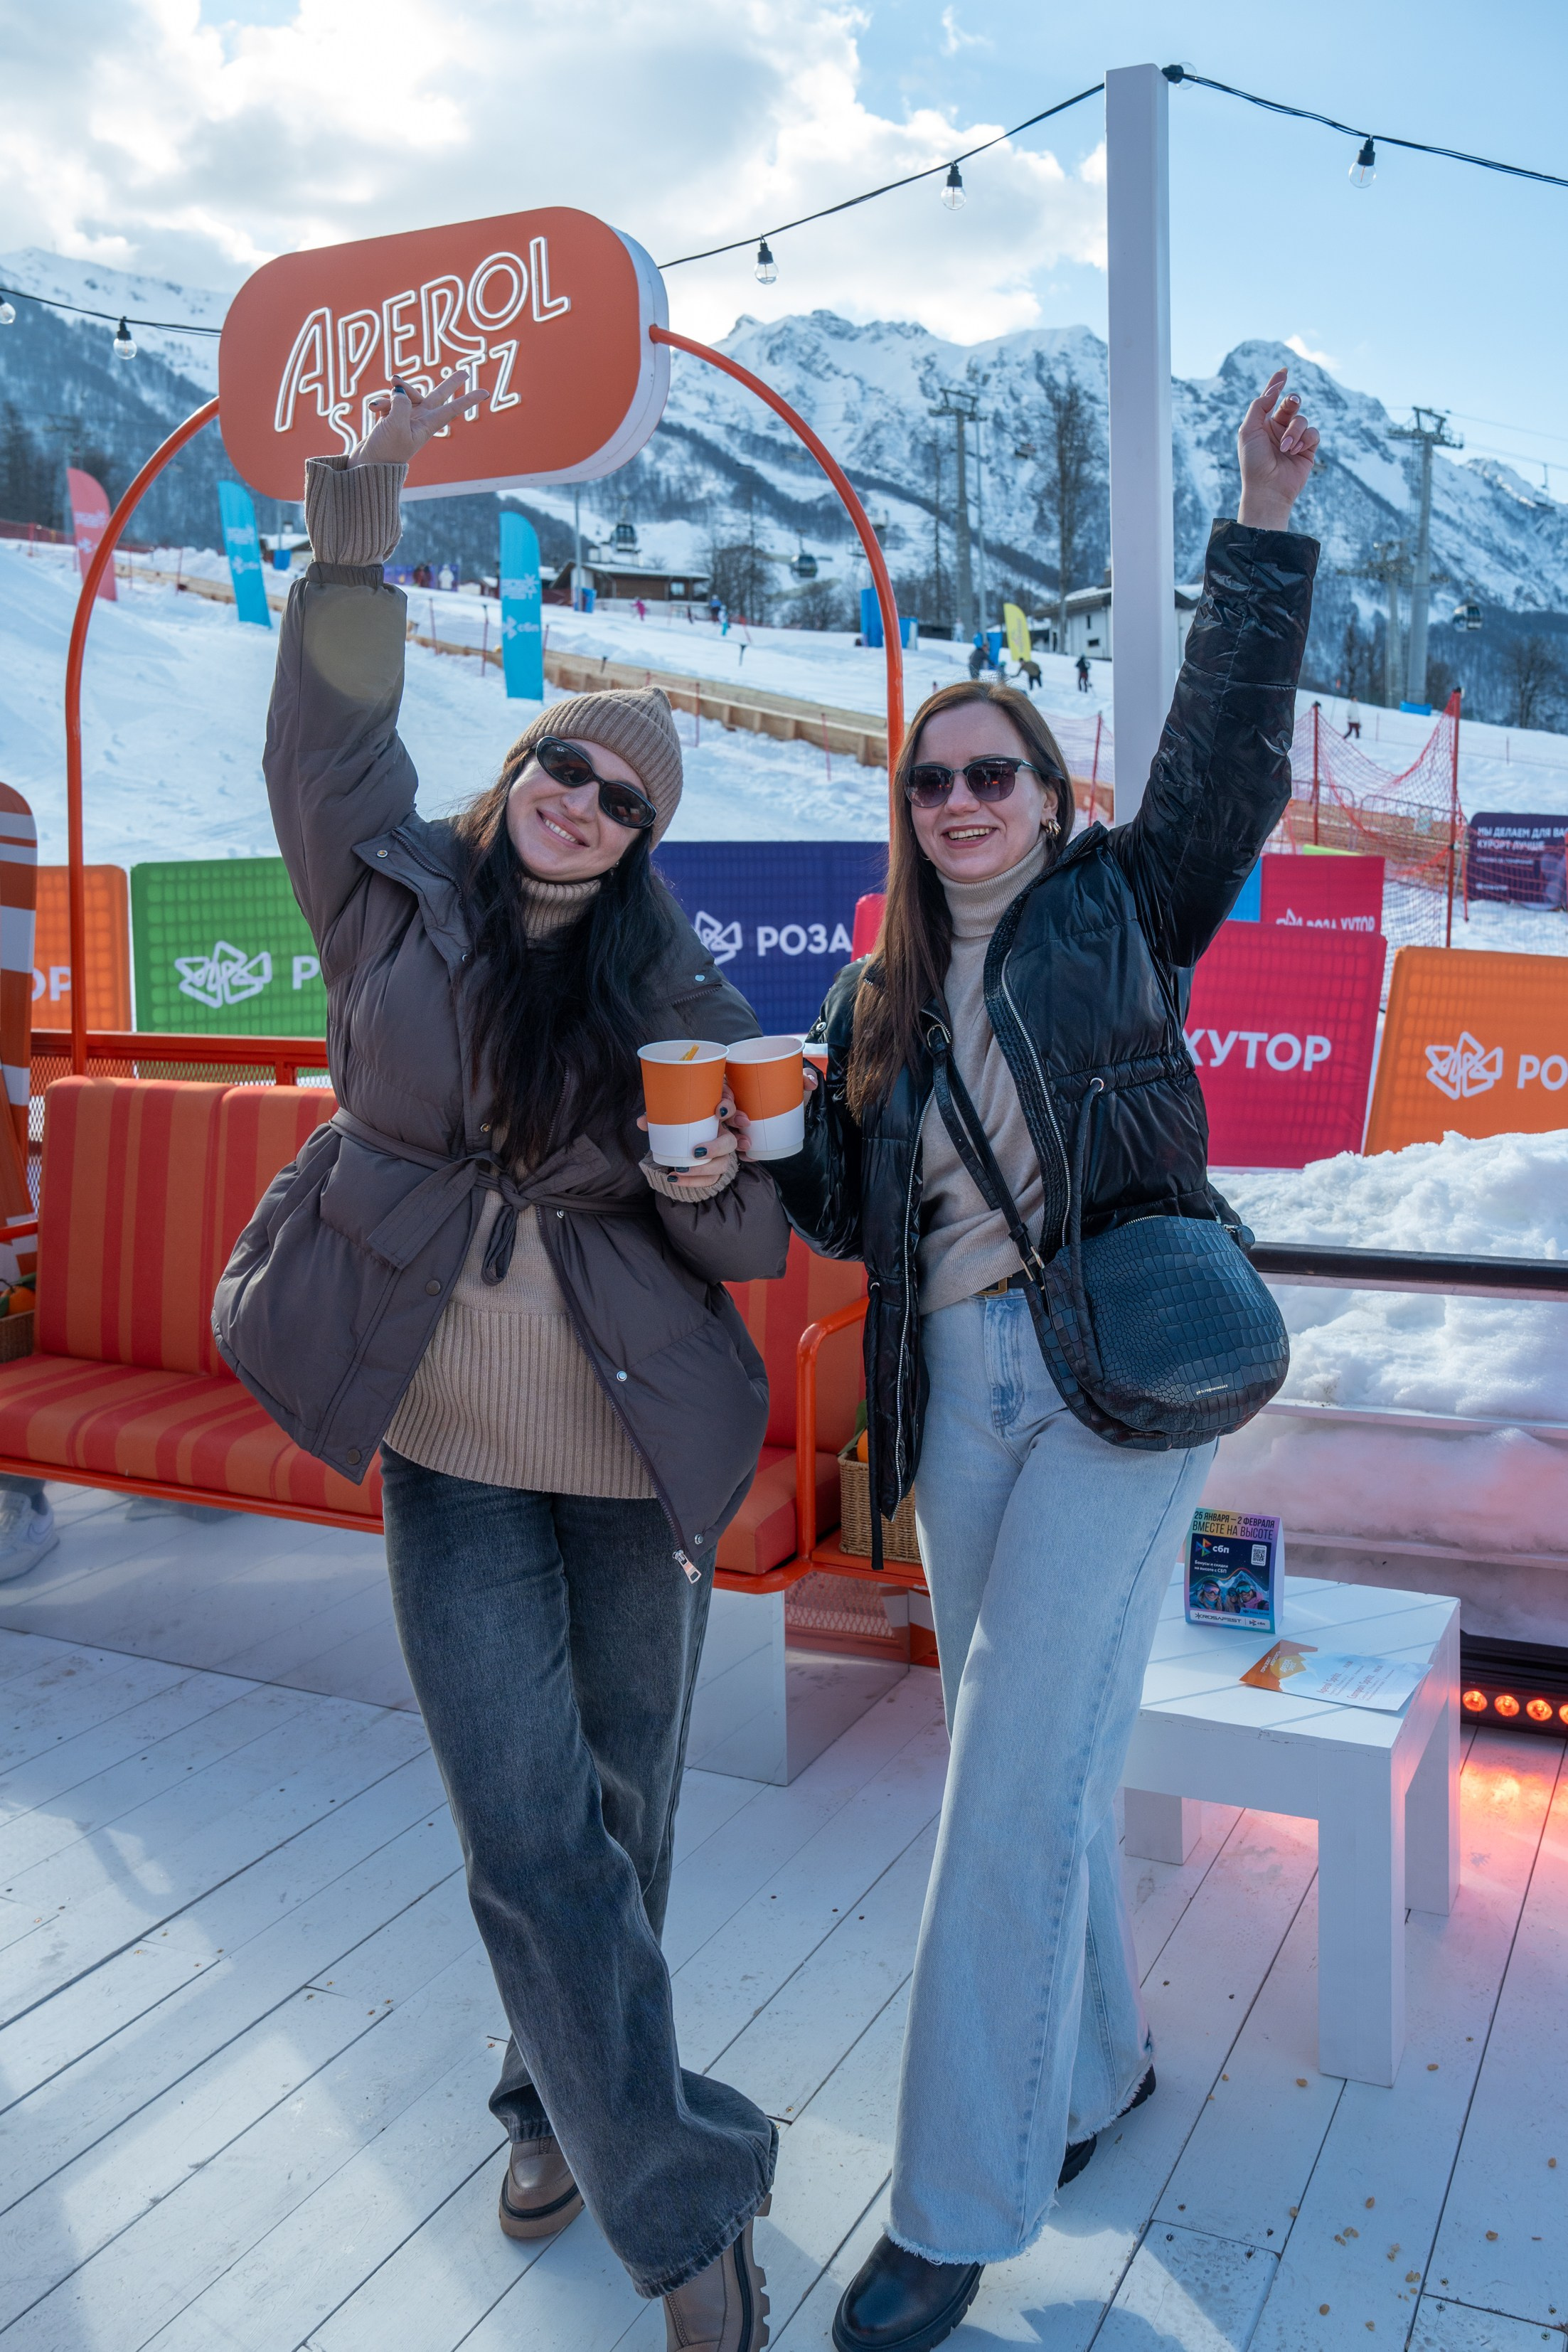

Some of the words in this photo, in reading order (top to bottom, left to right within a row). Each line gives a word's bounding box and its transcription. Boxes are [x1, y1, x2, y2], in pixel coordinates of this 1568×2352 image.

[274, 236, 571, 432] APEROL
[1478, 826, 1493, 836] МЫ
[1493, 827, 1530, 839] ДЕЛАЕМ
[1531, 827, 1552, 839] ДЛЯ
[757, 923, 852, 957] РОЗА
[1182, 1028, 1332, 1072] ХУТОР
[1195, 1511, 1202, 1520] 25
[1204, 1512, 1230, 1523] ЯНВАРЯ
[1243, 1517, 1275, 1528] ФЕВРАЛЯ
[1193, 1521, 1225, 1535] ВМЕСТЕ
[1227, 1525, 1238, 1536] НА
[1240, 1526, 1274, 1540] ВЫСОТЕ
[1212, 1545, 1230, 1553] сбп
